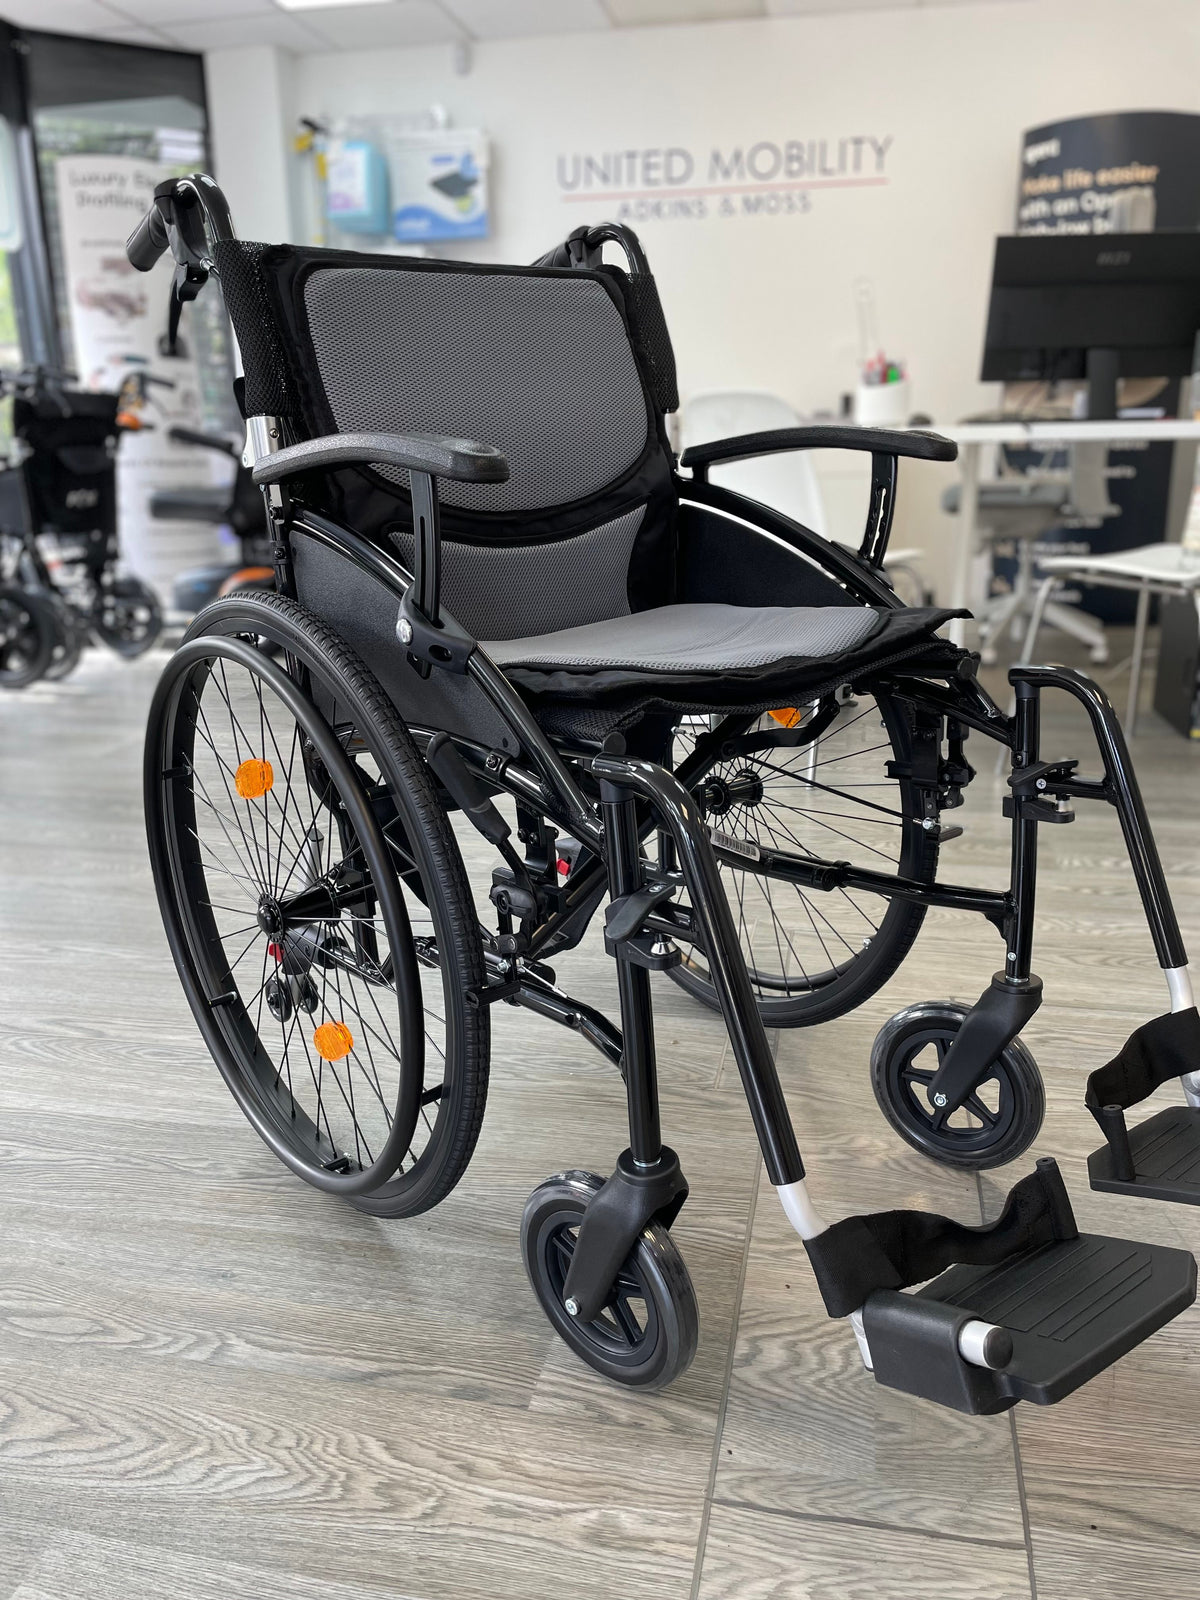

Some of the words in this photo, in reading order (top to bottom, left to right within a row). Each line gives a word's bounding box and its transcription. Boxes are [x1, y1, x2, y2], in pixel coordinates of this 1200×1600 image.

[556, 147, 695, 190] UNITED
[707, 134, 893, 184] MOBILITY
[1095, 161, 1159, 187] easier
[616, 198, 708, 221] ADKINS
[740, 190, 813, 215] MOSS
